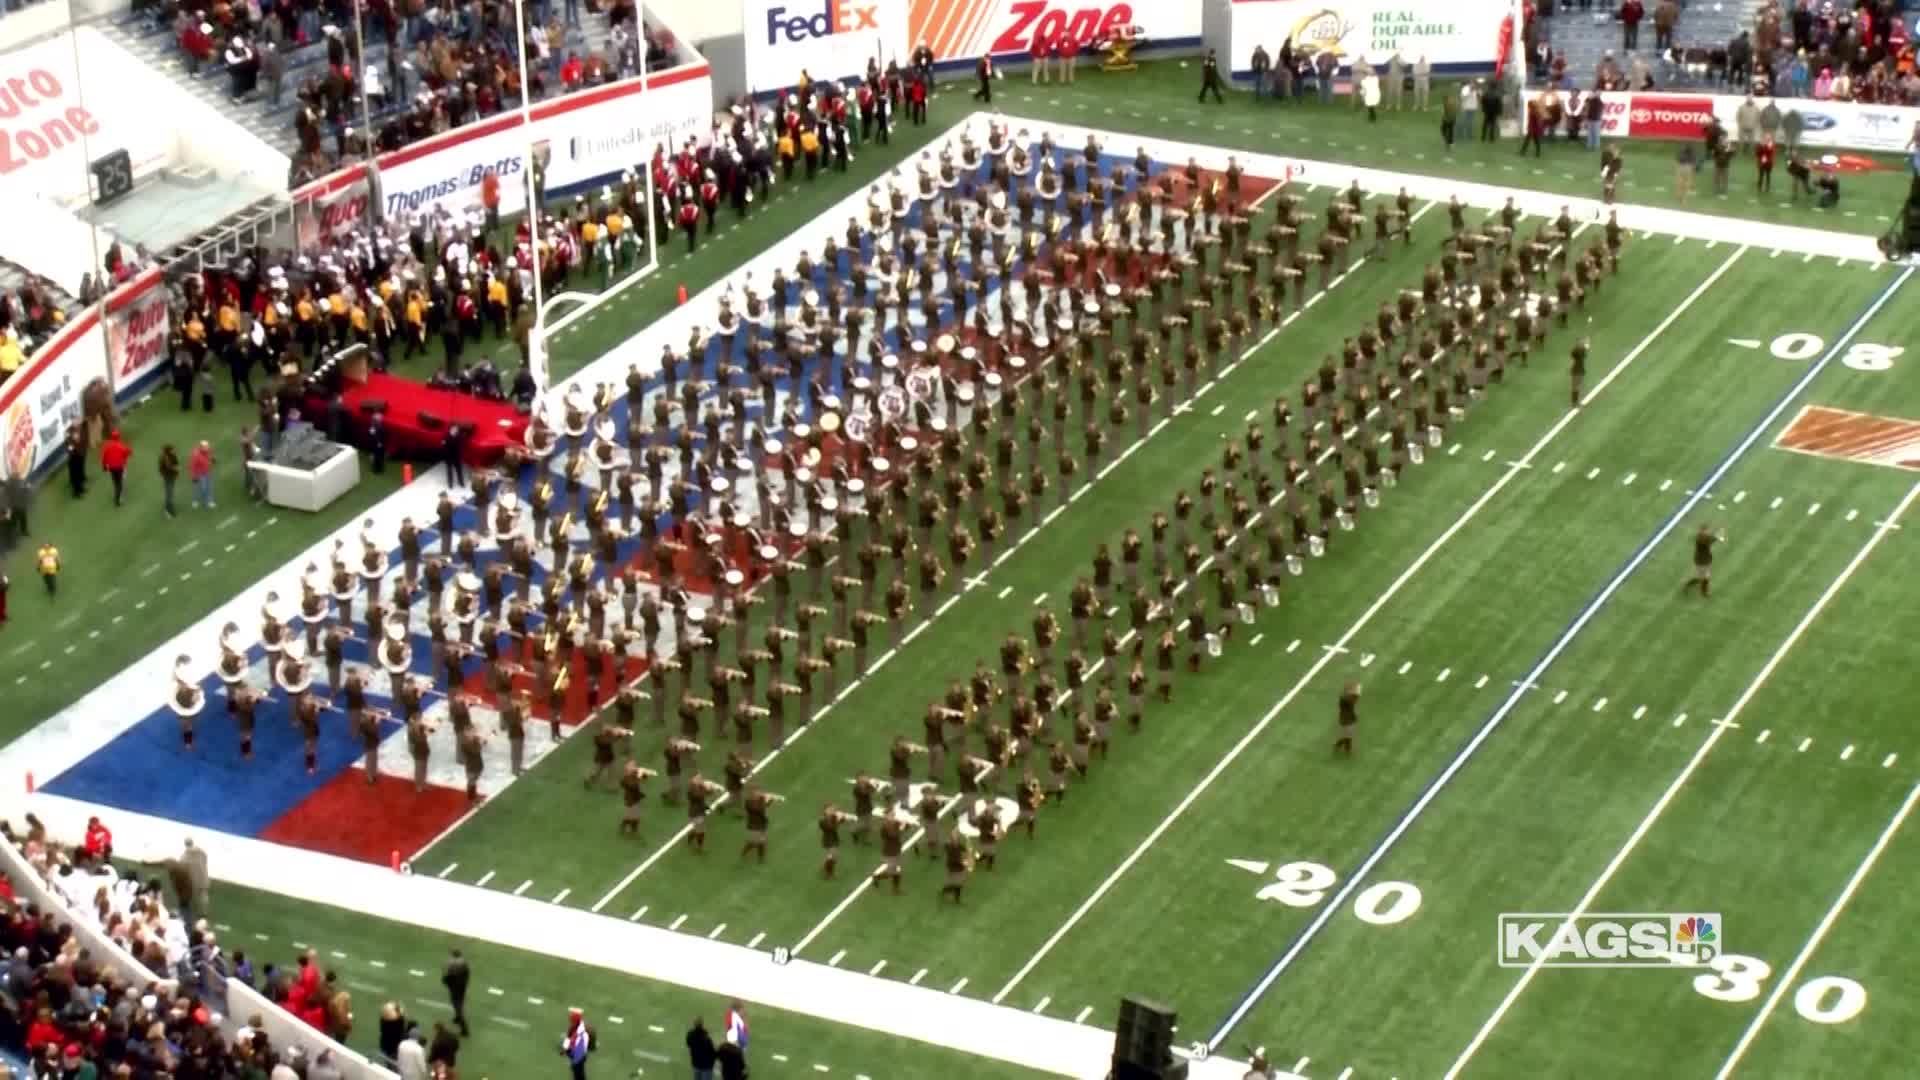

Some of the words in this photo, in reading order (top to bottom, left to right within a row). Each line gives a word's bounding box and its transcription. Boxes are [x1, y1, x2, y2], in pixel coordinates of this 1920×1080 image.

[767, 0, 879, 45] FedEx
[990, 0, 1133, 51] Zone
[1653, 109, 1711, 124] TOYOTA
[103, 159, 129, 195] 25
